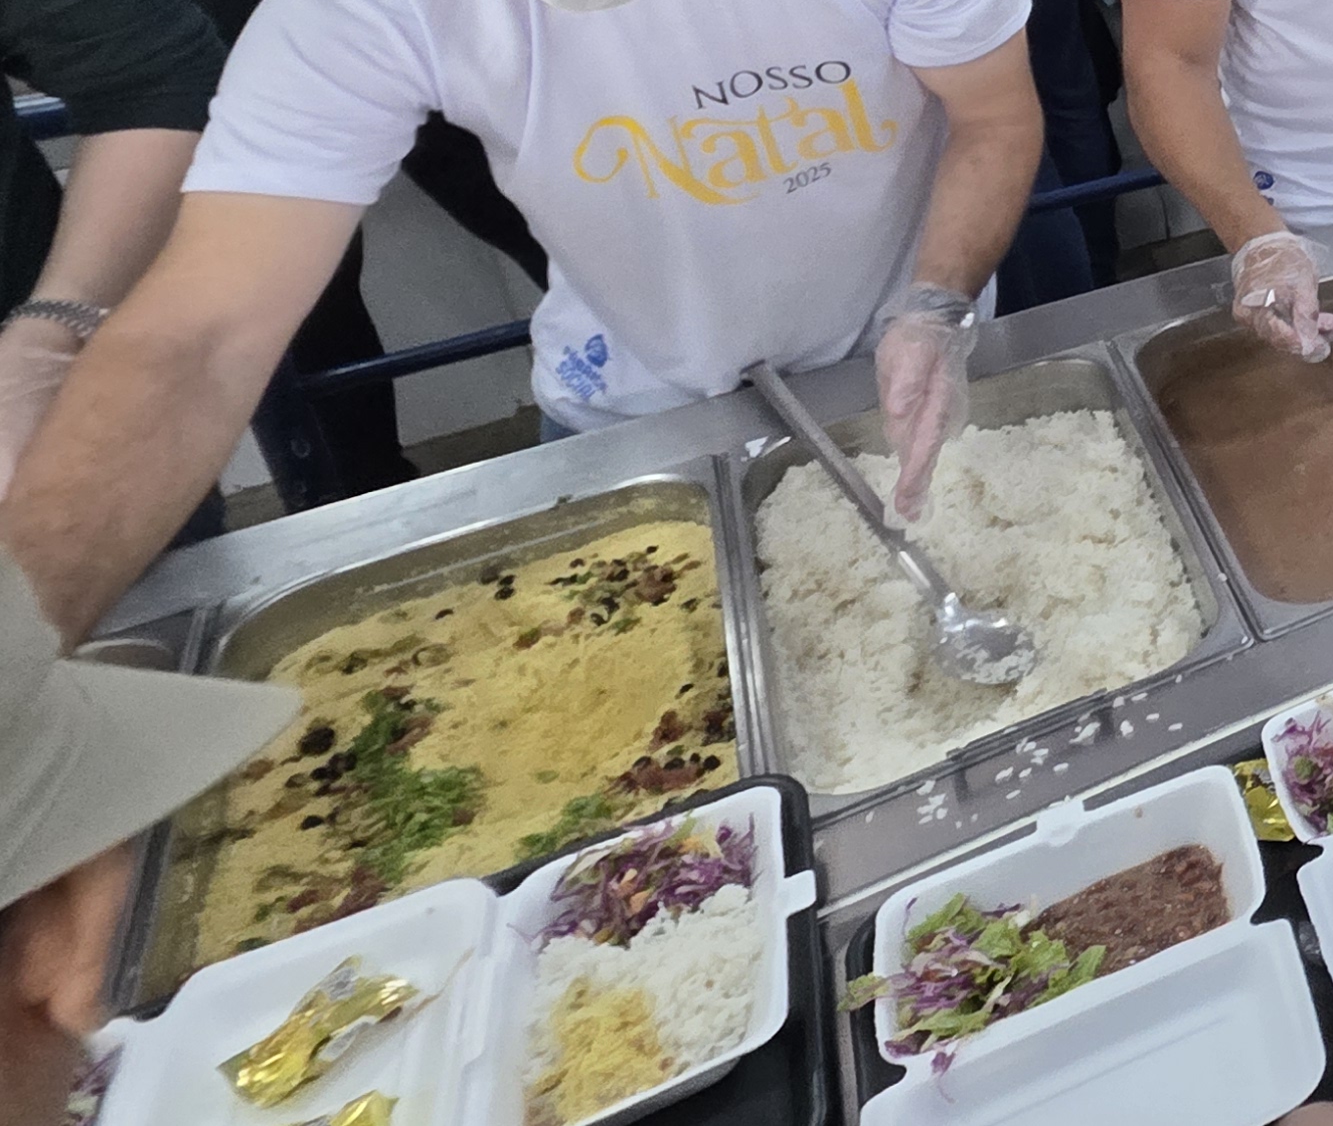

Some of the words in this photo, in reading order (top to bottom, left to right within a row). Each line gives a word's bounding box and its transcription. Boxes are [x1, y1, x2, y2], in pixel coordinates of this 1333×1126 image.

[692, 61, 851, 109] NOSSO
[573, 79, 897, 205] Natal
[782, 162, 832, 194] 2025
